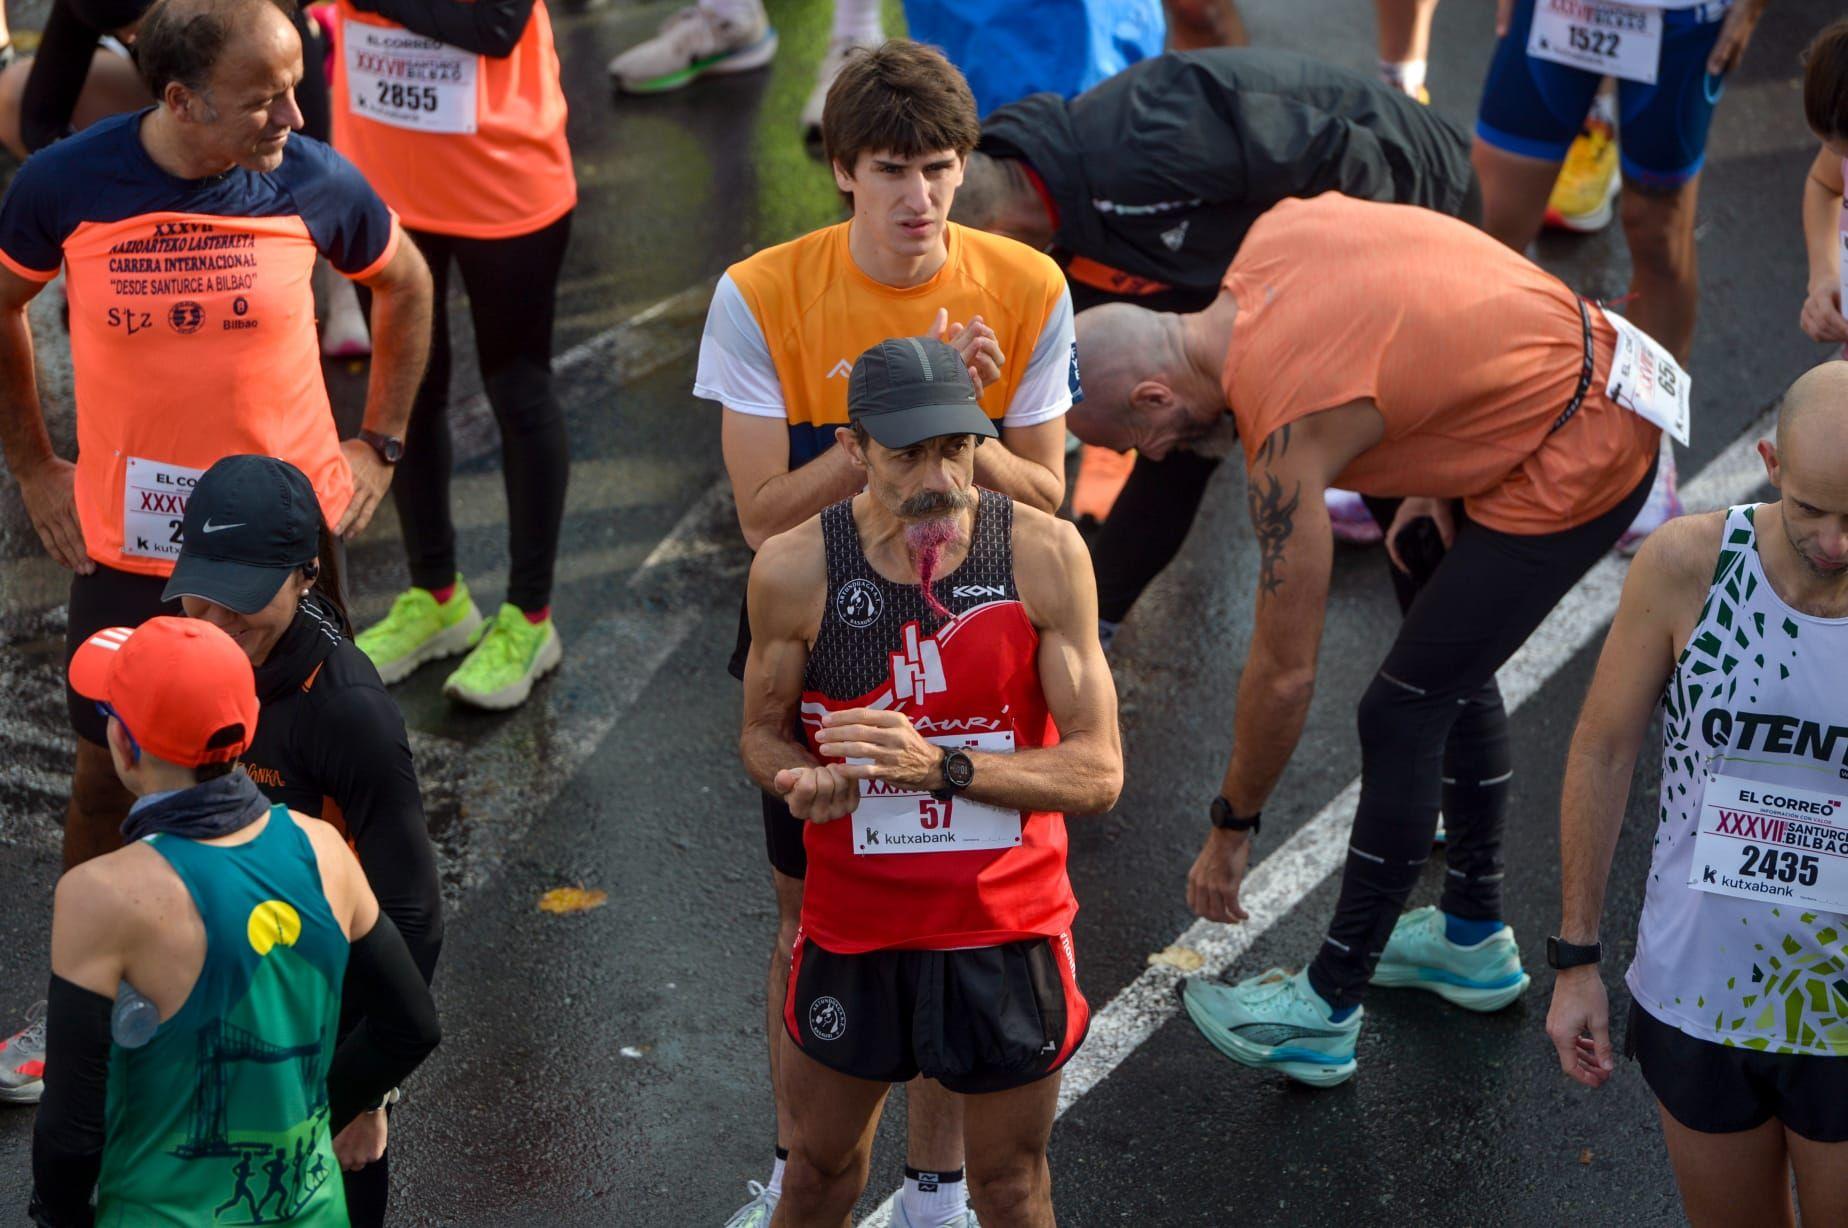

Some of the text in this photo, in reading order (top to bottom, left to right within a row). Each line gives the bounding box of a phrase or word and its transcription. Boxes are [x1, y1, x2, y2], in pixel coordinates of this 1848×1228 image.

[1569, 24, 1621, 58] 1522
[378, 80, 438, 113] 2855
[188, 234, 255, 253] LASTERKETA
[109, 254, 257, 273] CARRERA INTERNACIONAL
[151, 277, 203, 295] SANTURCE
[206, 277, 214, 292] A
[223, 319, 258, 330] Bilbao
[156, 473, 174, 485] EL
[141, 491, 189, 514] XXXV
[908, 705, 1009, 732] AURI
[1739, 790, 1834, 816] EL CORREO
[918, 799, 953, 830] 57
[1813, 817, 1832, 825] VALOR
[1716, 810, 1785, 843] XXXVII
[1788, 822, 1848, 842] SANTURC
[885, 831, 956, 845] kutxabank
[1786, 833, 1848, 854] BILBAO
[1739, 845, 1819, 887] 2435
[1722, 875, 1793, 897] kutxabank
